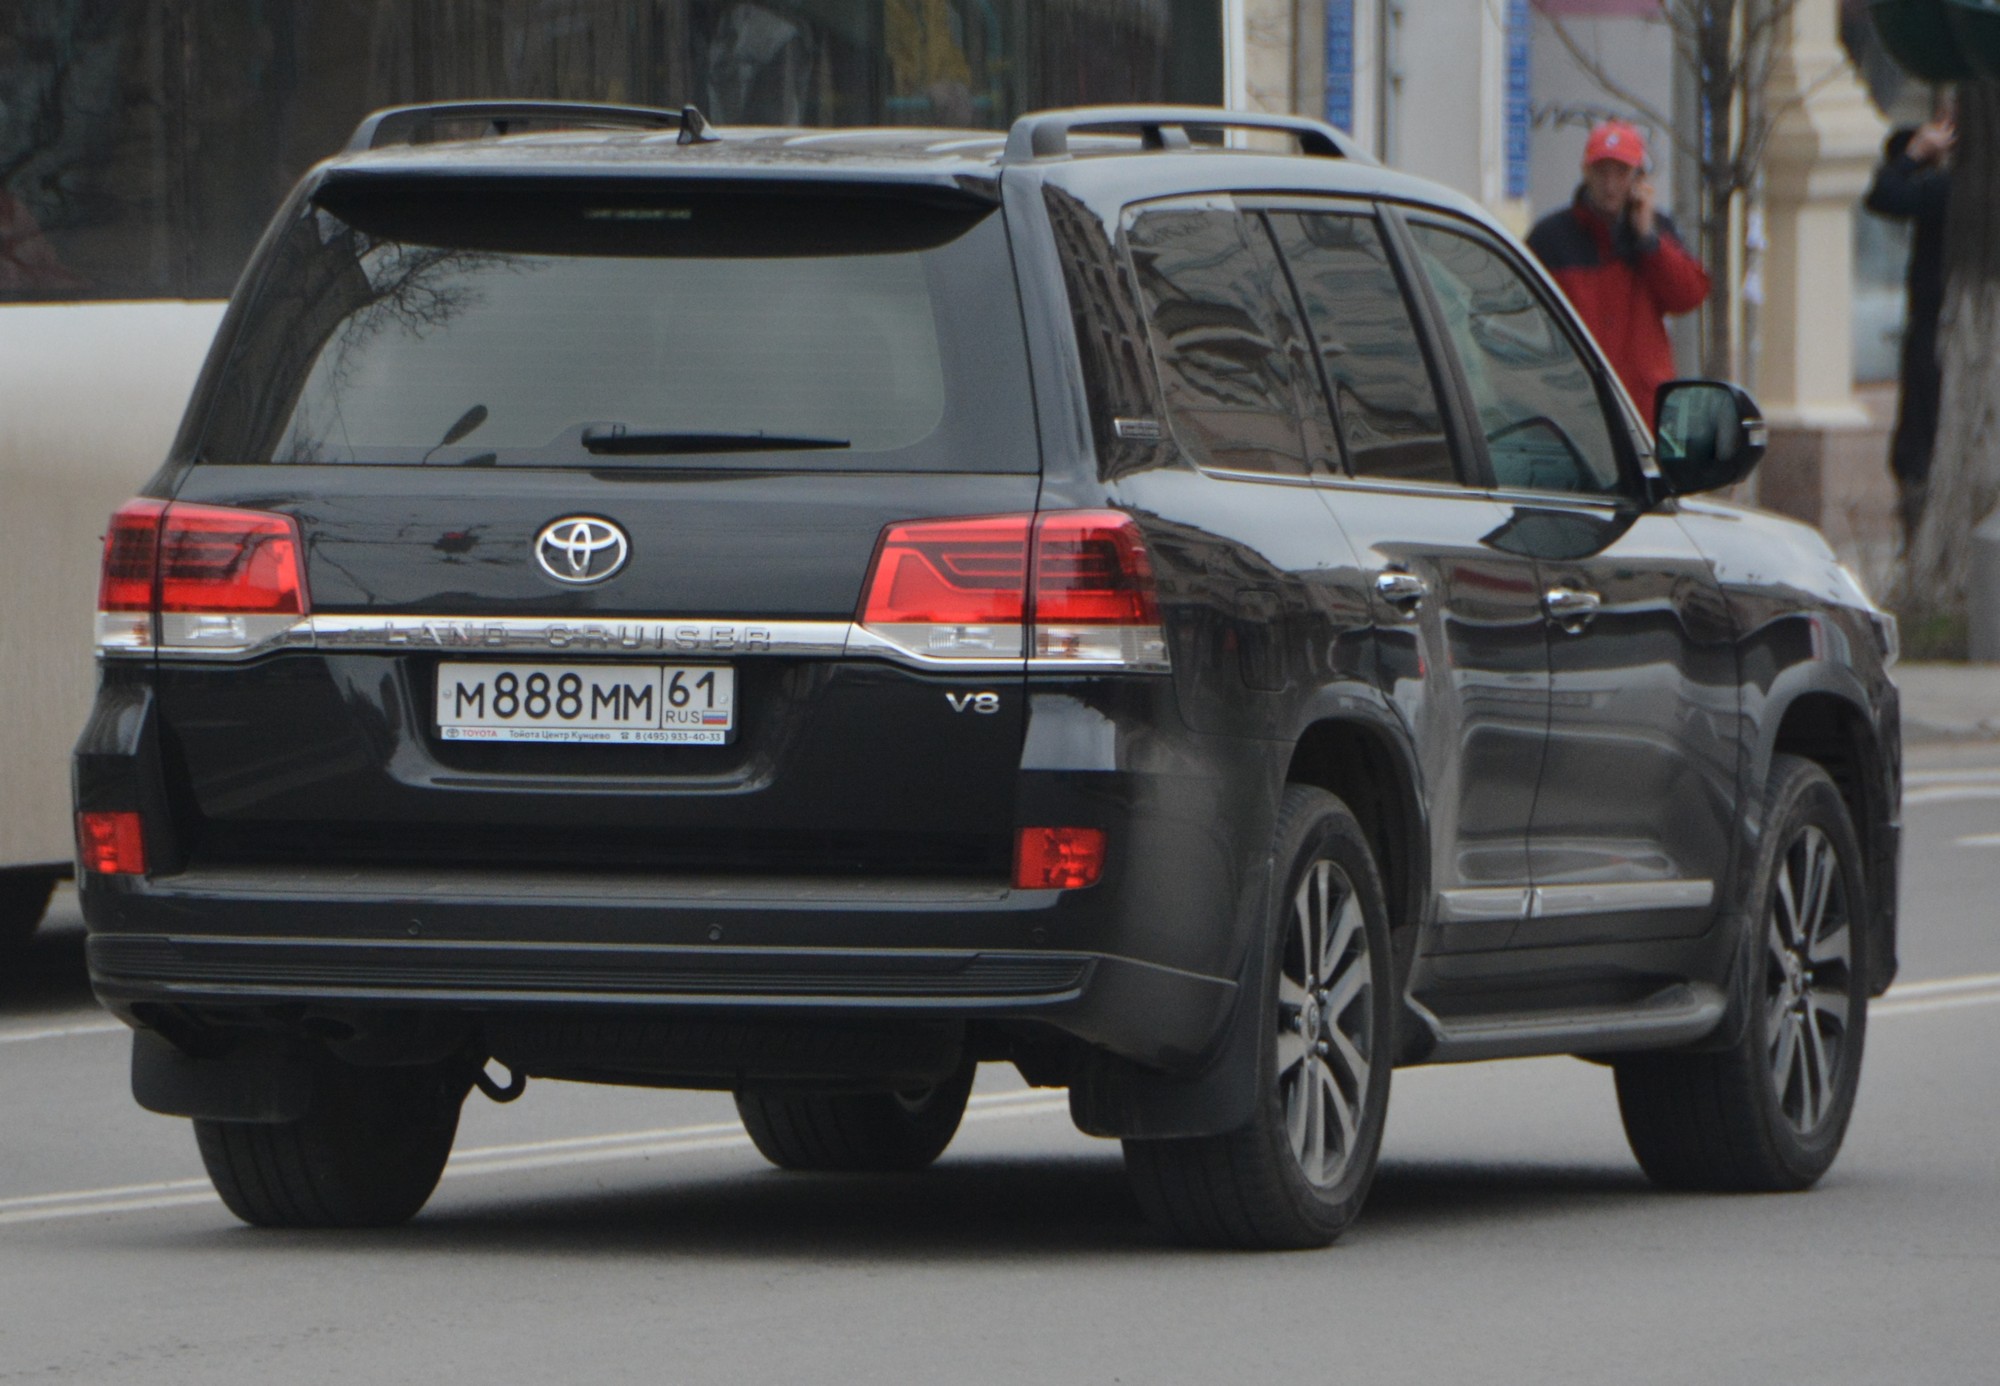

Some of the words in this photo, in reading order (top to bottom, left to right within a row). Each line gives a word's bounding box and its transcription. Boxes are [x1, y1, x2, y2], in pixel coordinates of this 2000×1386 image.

[385, 621, 508, 646] LAND
[546, 624, 771, 651] CRUISER
[668, 671, 714, 708] 61
[945, 691, 1000, 714] V8
[665, 710, 700, 723] RUS
[462, 729, 498, 738] TOYOTA
[509, 730, 540, 739] Тойота
[541, 731, 569, 741] Центр
[571, 731, 611, 742] Кунцево
[635, 732, 641, 740] 8
[643, 732, 669, 741] (495)
